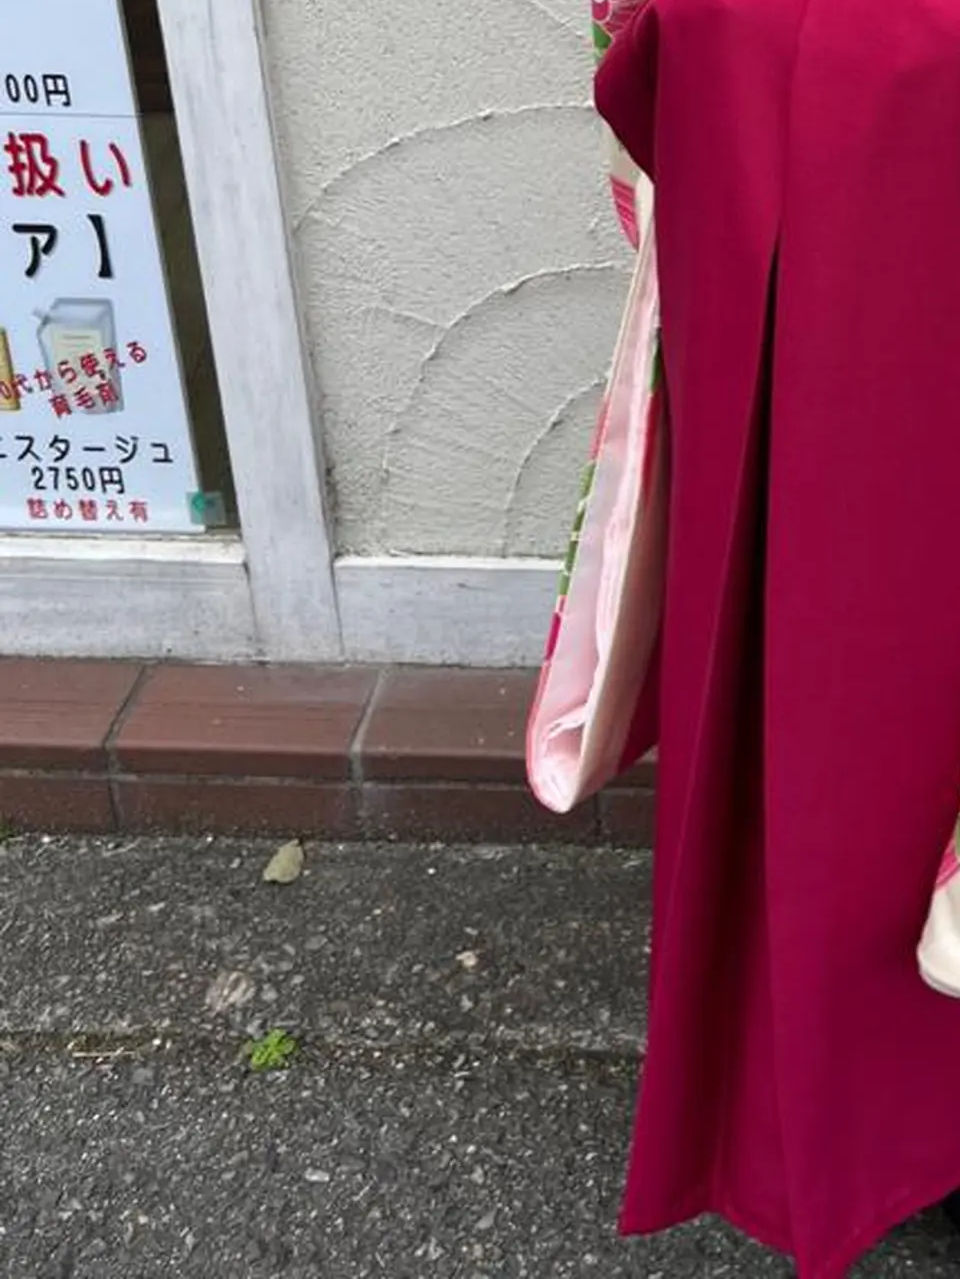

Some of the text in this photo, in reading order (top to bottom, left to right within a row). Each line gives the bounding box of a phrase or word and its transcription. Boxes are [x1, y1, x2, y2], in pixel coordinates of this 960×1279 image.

[4, 132, 132, 198] 扱い
[31, 466, 125, 494] 2750円
[27, 497, 149, 522] 詰め替え有
